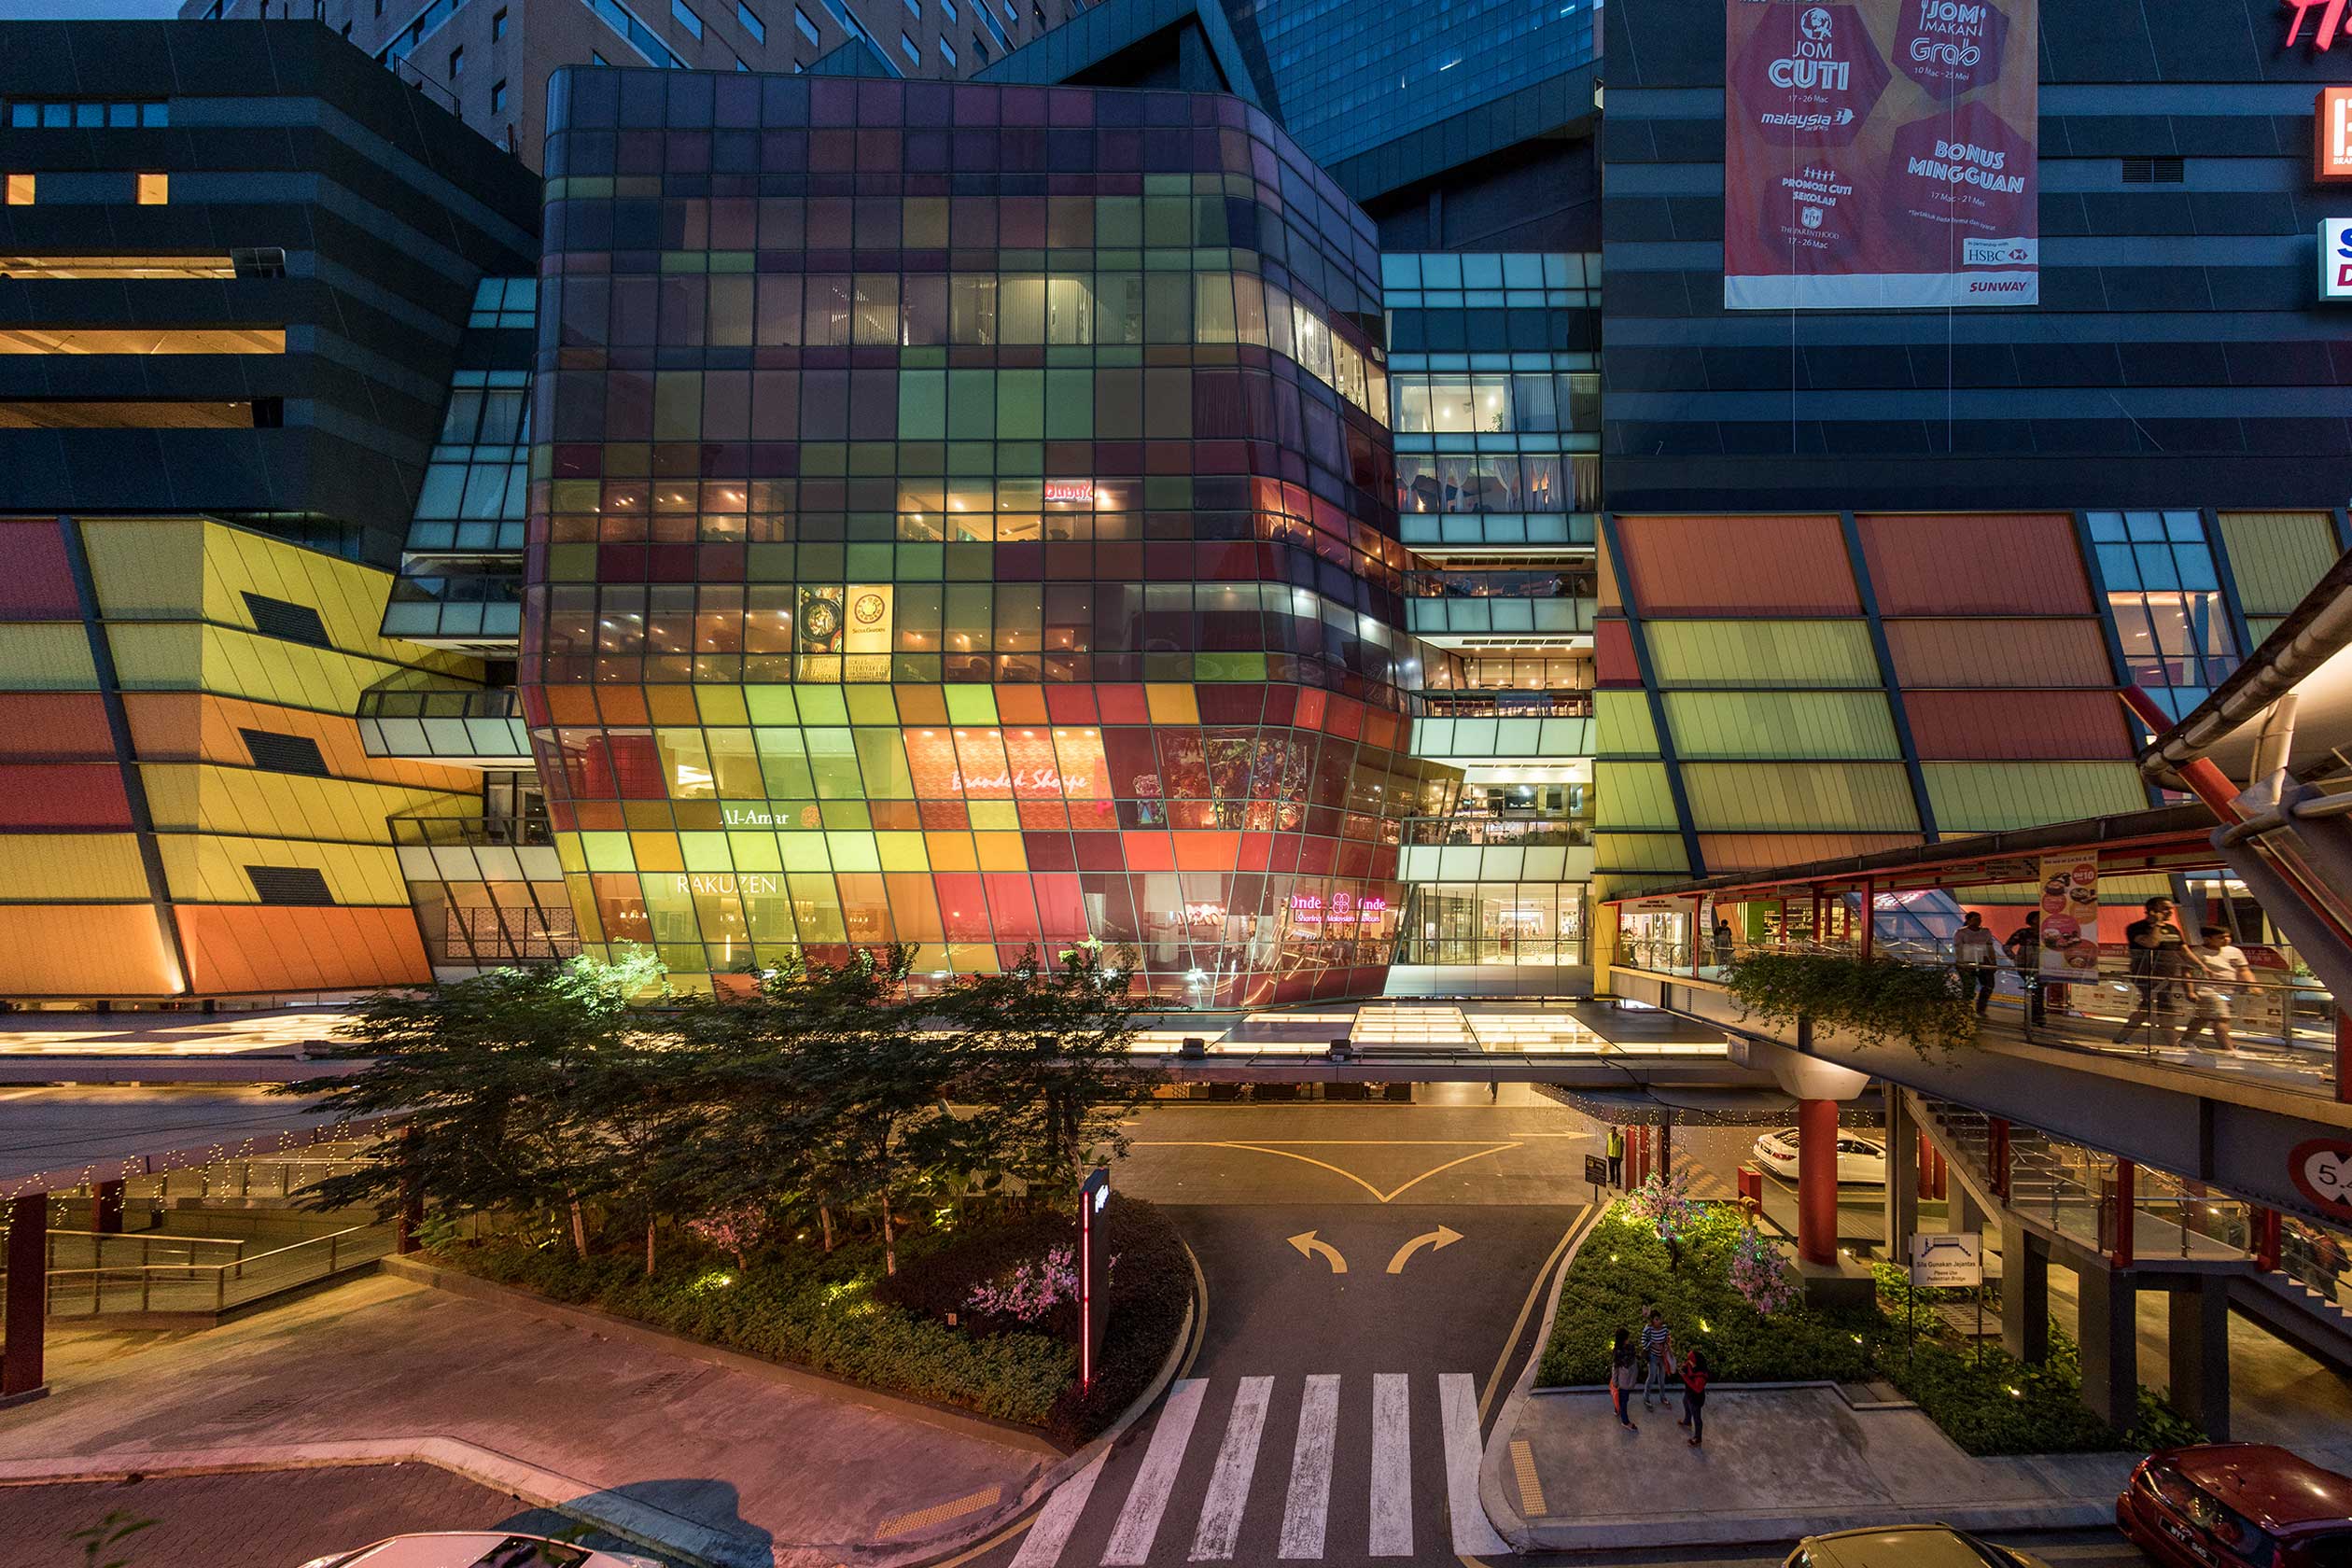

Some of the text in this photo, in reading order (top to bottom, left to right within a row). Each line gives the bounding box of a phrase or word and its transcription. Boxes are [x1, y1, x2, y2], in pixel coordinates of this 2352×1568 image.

[1926, 0, 1980, 24] JOM
[1925, 21, 1977, 36] MAKAN
[1792, 40, 1832, 59] JOM
[1911, 37, 1981, 66] Grab
[1769, 58, 1850, 91] CUTI
[1813, 95, 1828, 104] Mac
[1761, 113, 1832, 129] malaysia
[1934, 140, 2005, 169] BONUS
[1908, 156, 2025, 194] MINGGUAN
[1782, 177, 1853, 195] PROMOSI CUTI
[1793, 190, 1837, 206] SEKOLAH
[1969, 249, 2006, 262] HSBC
[1969, 282, 2027, 293] SUNWAY
[951, 769, 1086, 793] Branded Shoppe
[719, 809, 790, 825] Al-Amar
[677, 875, 777, 894] RAKUZEN
